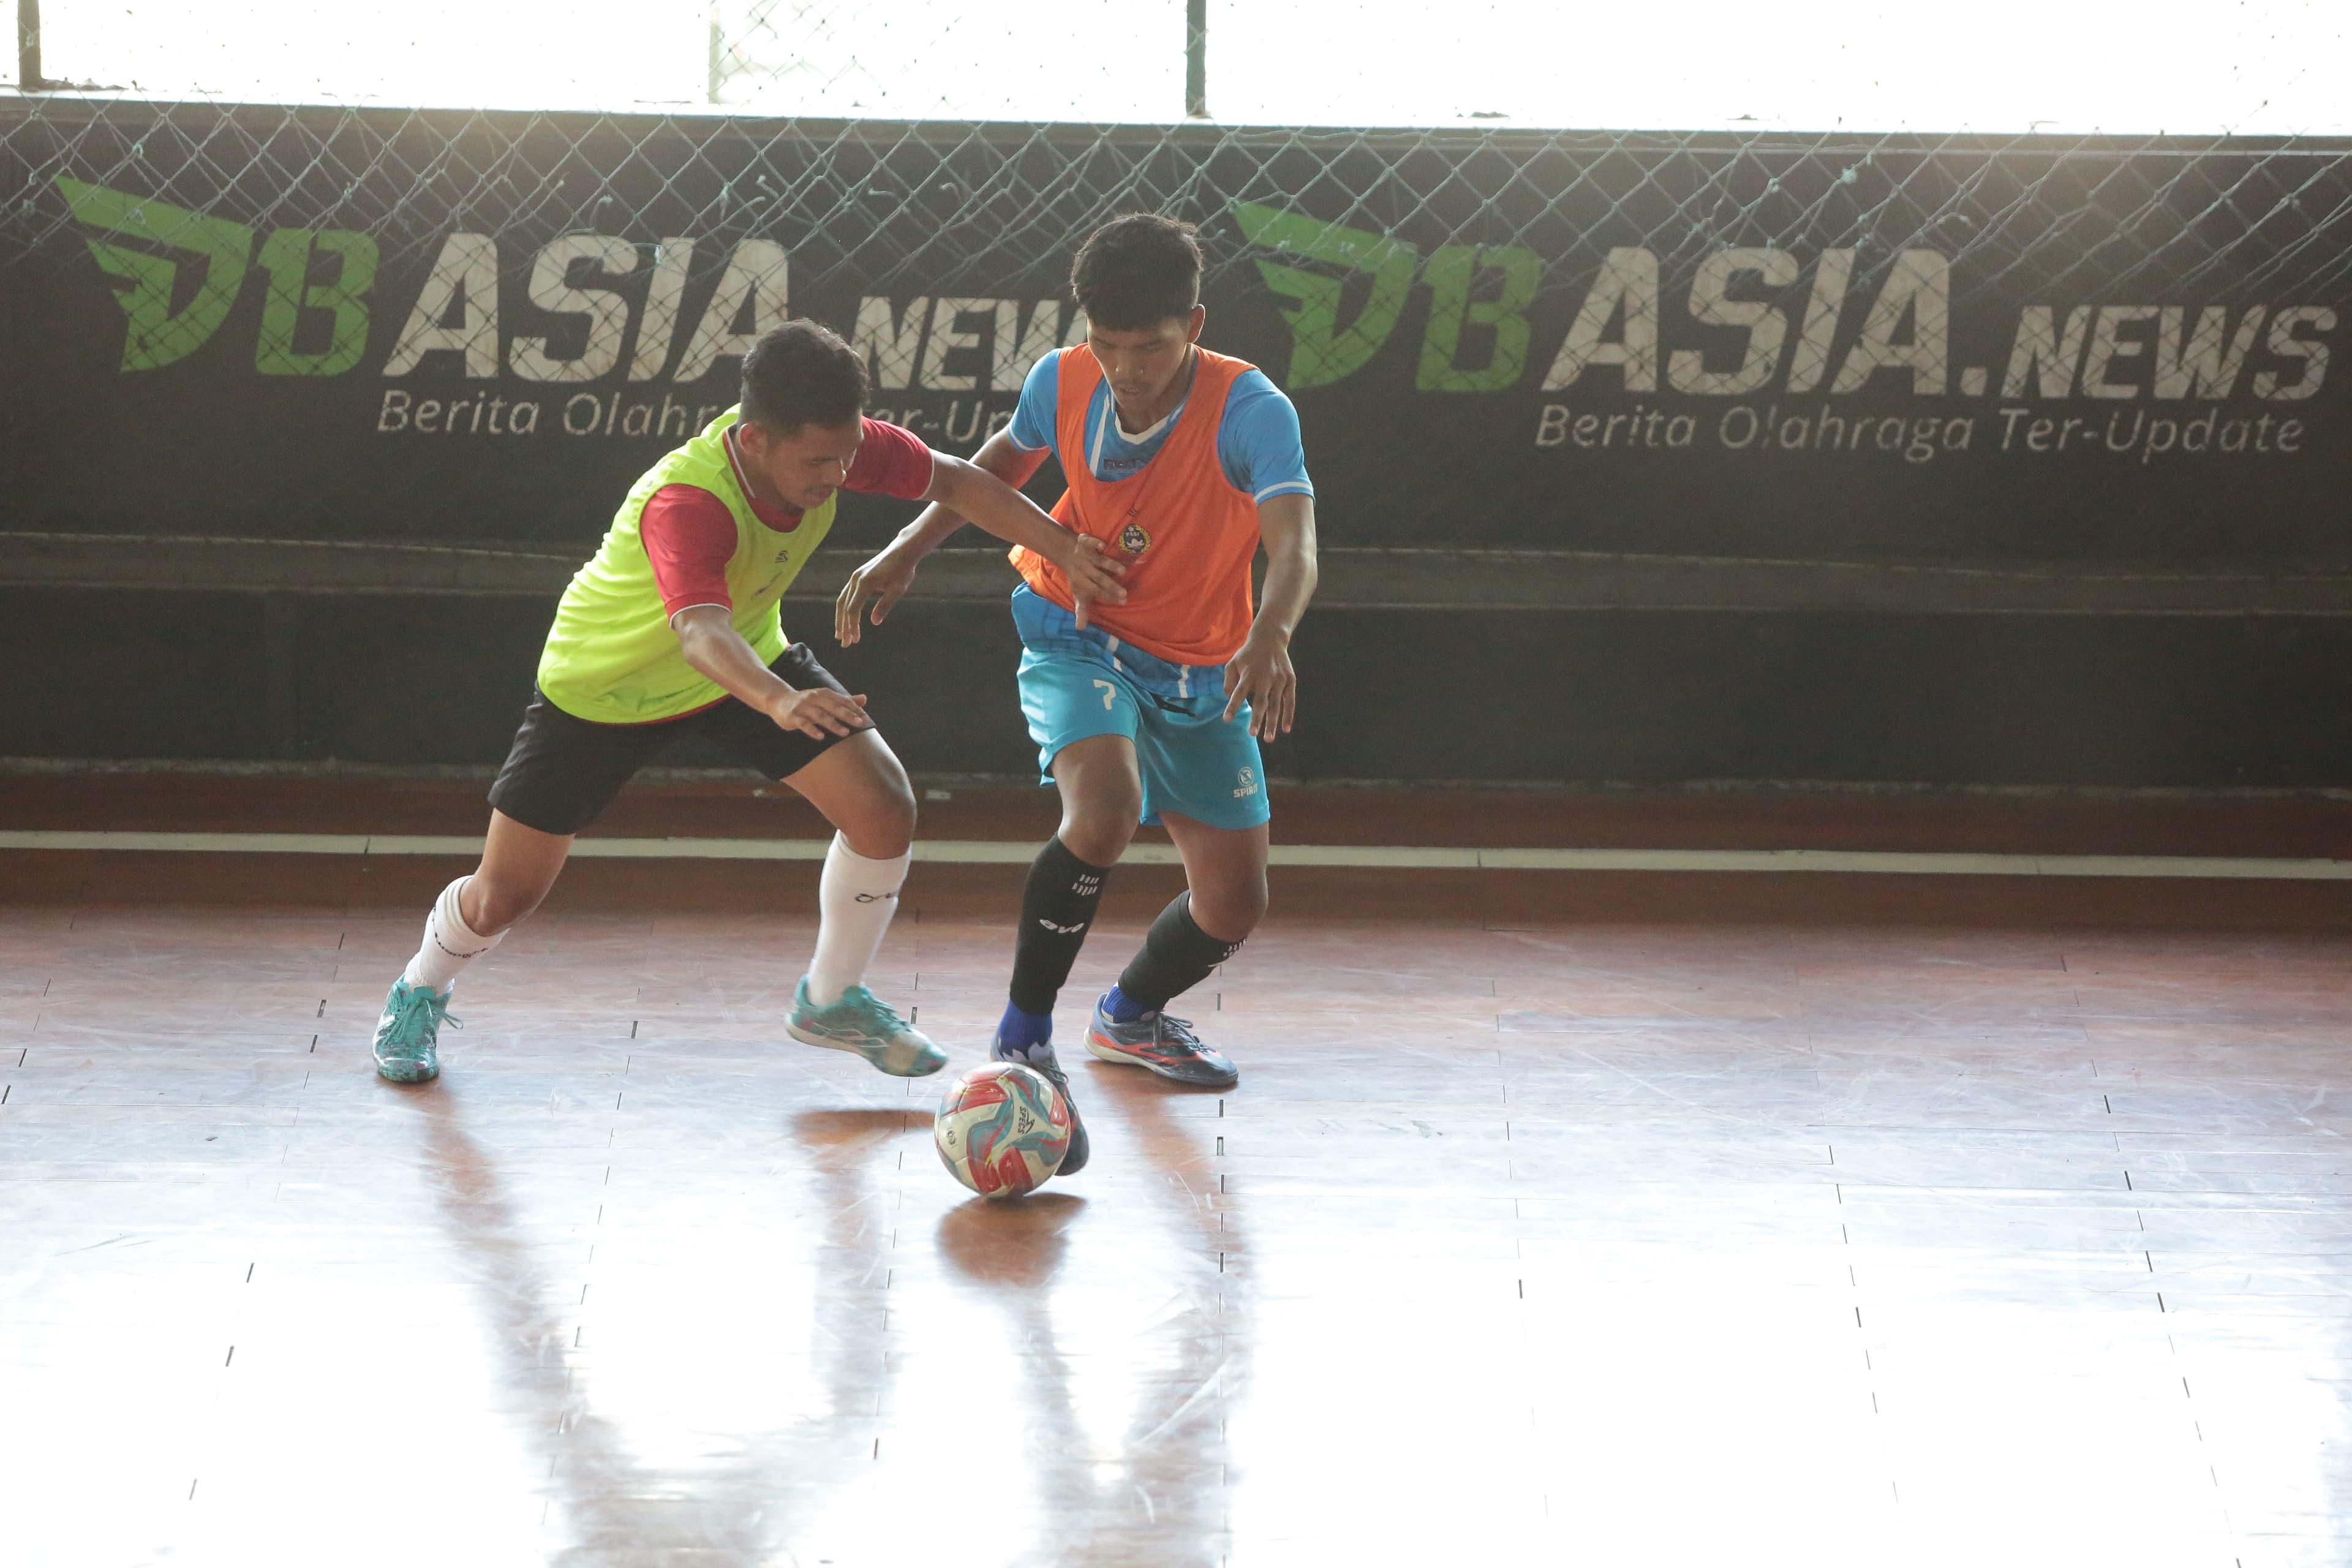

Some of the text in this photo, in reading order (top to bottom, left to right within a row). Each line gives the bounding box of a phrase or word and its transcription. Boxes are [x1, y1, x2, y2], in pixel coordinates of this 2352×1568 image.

[377, 389, 540, 434] Berita
[563, 392, 718, 437] Olahr
[1536, 404, 1696, 449] Berita
[1999, 408, 2305, 463] Ter-Update
[1093, 679, 1116, 710] 7
[1018, 1106, 1027, 1134] SPECS
